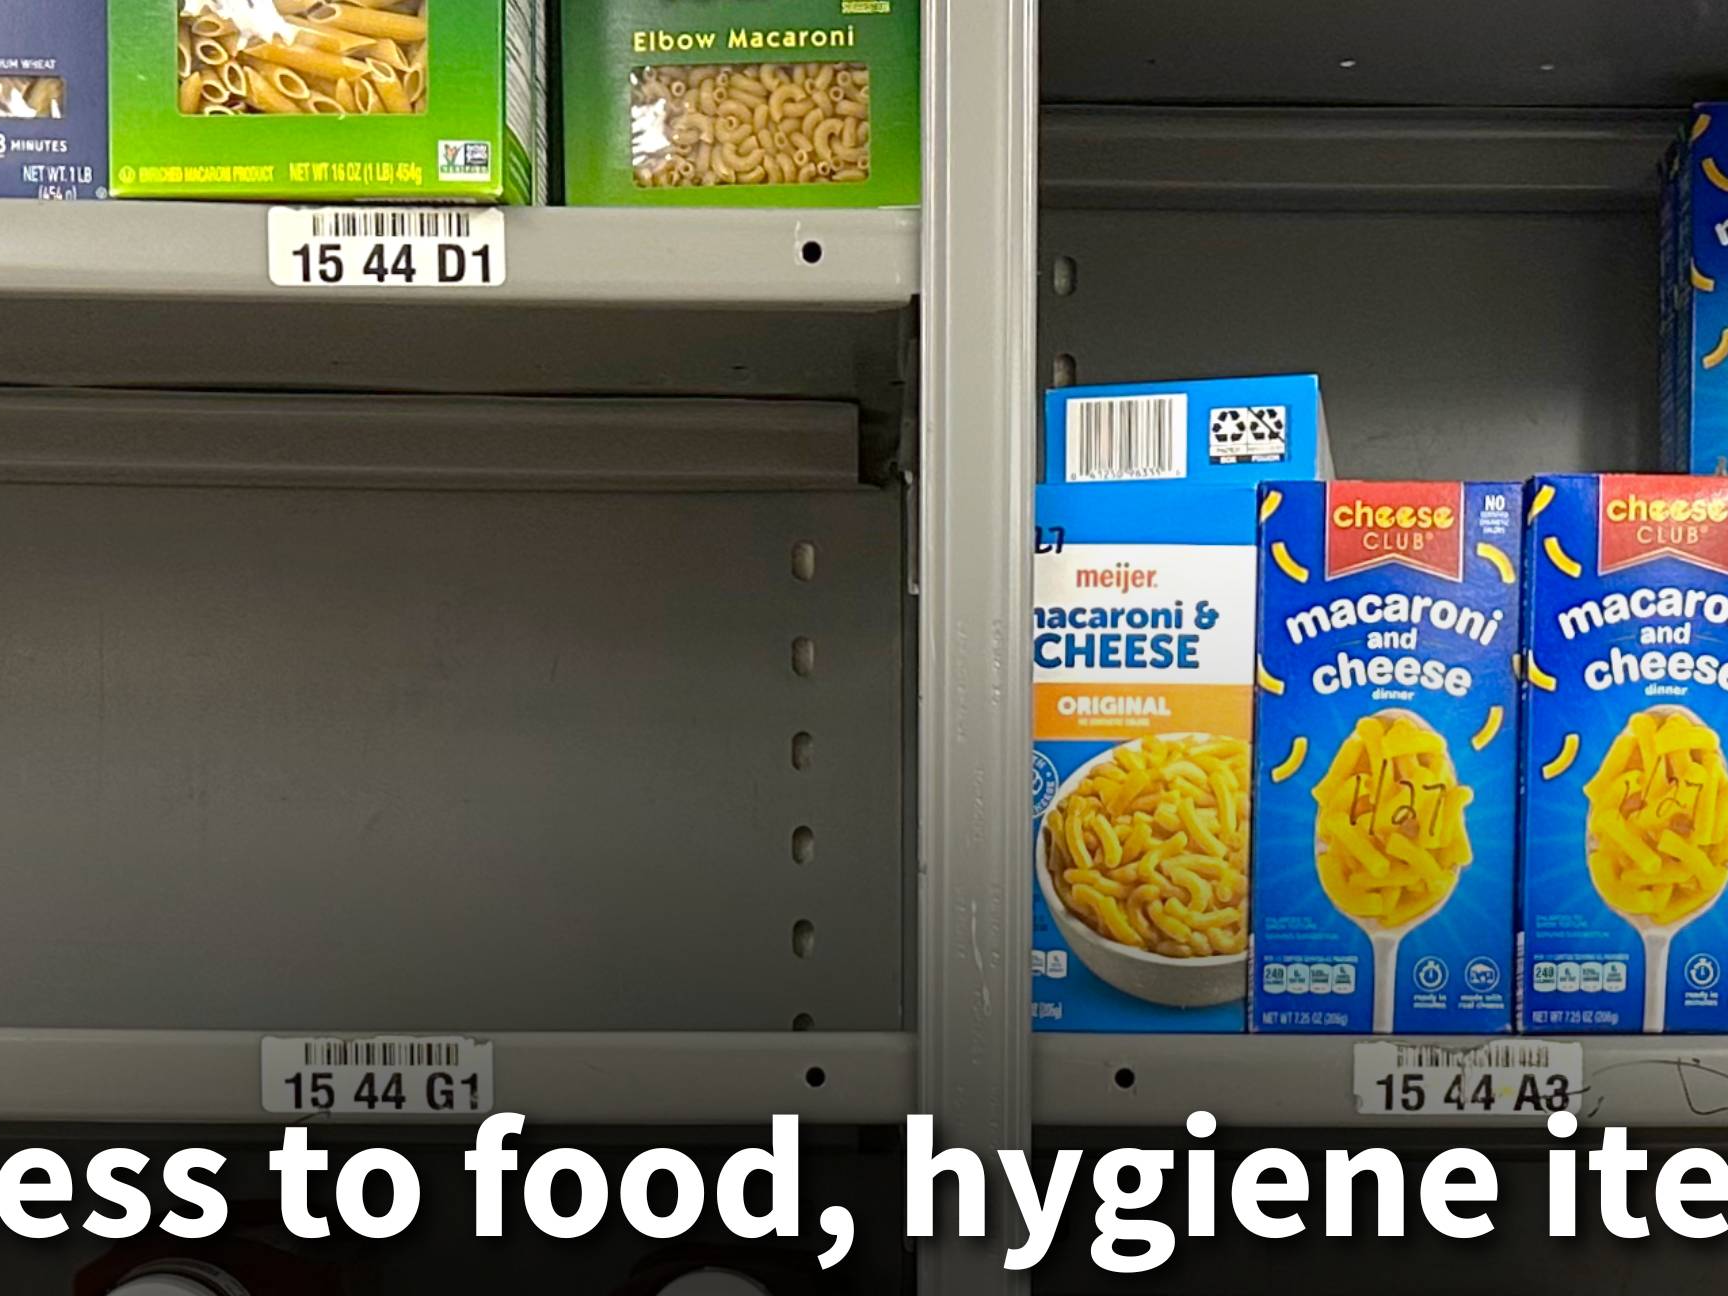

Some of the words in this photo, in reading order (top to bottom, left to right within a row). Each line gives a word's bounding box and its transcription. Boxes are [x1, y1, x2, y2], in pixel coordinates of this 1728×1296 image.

[632, 28, 715, 54] Elbow
[726, 24, 855, 52] Macaroni
[292, 245, 345, 284] 15
[363, 244, 417, 284] 44
[436, 243, 492, 284] D1
[1332, 500, 1456, 531] cheese
[1362, 532, 1427, 551] CLUB
[1285, 593, 1503, 646] macaroni
[1312, 653, 1472, 697] cheese
[1057, 696, 1171, 717] ORIGINAL
[284, 1072, 335, 1109] 15
[354, 1072, 406, 1109] 44
[425, 1072, 478, 1110] G1
[1374, 1072, 1425, 1113] 15
[1443, 1072, 1496, 1112] 44
[1513, 1072, 1570, 1113] A3
